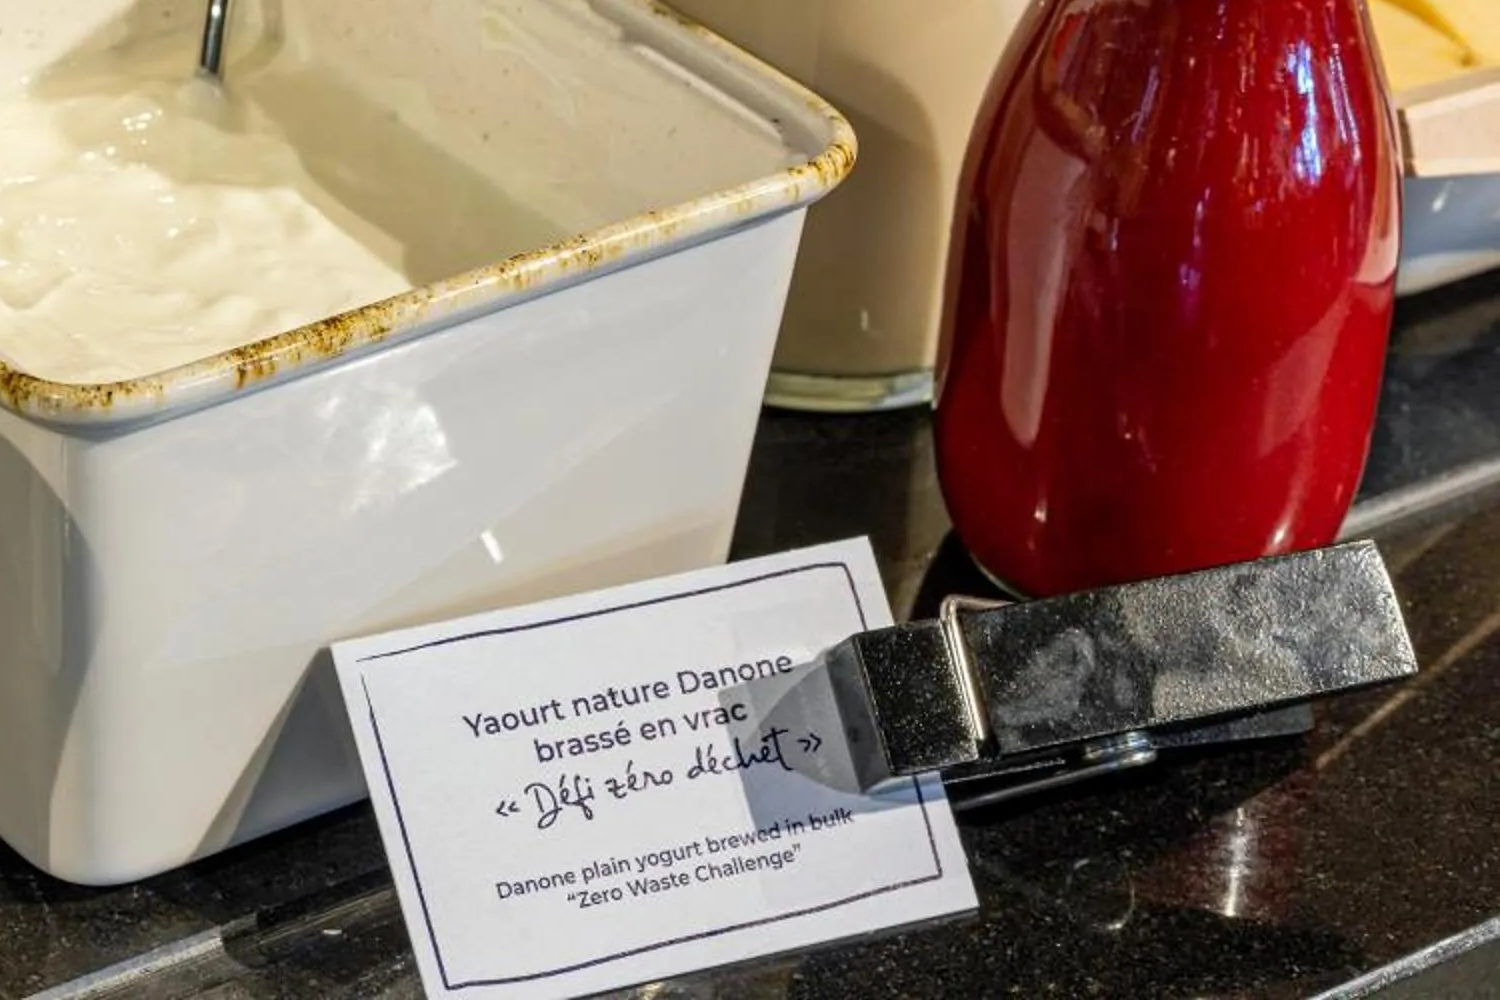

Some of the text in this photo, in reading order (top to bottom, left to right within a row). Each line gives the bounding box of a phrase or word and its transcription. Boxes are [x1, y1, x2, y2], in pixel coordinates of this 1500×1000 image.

[462, 654, 794, 738] Yaourt nature Danone
[533, 702, 749, 763] brassé en vrac
[605, 760, 674, 799] zéro
[496, 806, 854, 900] Danone plain yogurt brewed in bulk
[627, 872, 690, 898] Waste
